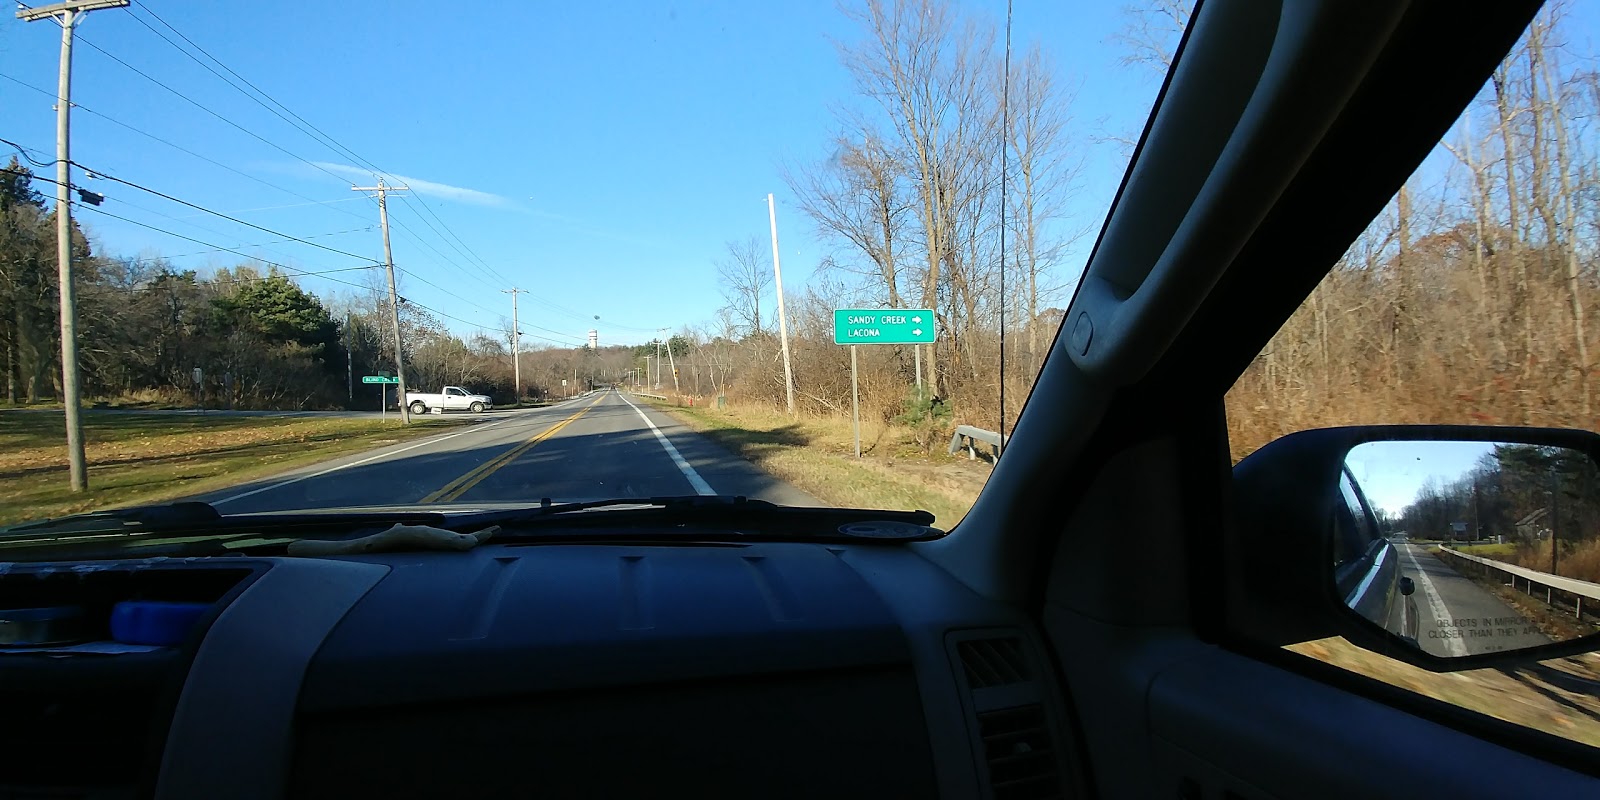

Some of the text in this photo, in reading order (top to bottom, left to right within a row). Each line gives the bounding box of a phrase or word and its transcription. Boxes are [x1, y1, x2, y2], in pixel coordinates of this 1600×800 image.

[848, 316, 906, 324] SANDY CREEK
[848, 329, 880, 337] LACONA
[1436, 618, 1477, 627] OBJECTS
[1483, 618, 1492, 626] IN
[1495, 616, 1527, 625] MIRROR
[1428, 629, 1464, 639] CLOSER
[1469, 629, 1493, 637] THAN
[1497, 627, 1517, 637] THEY
